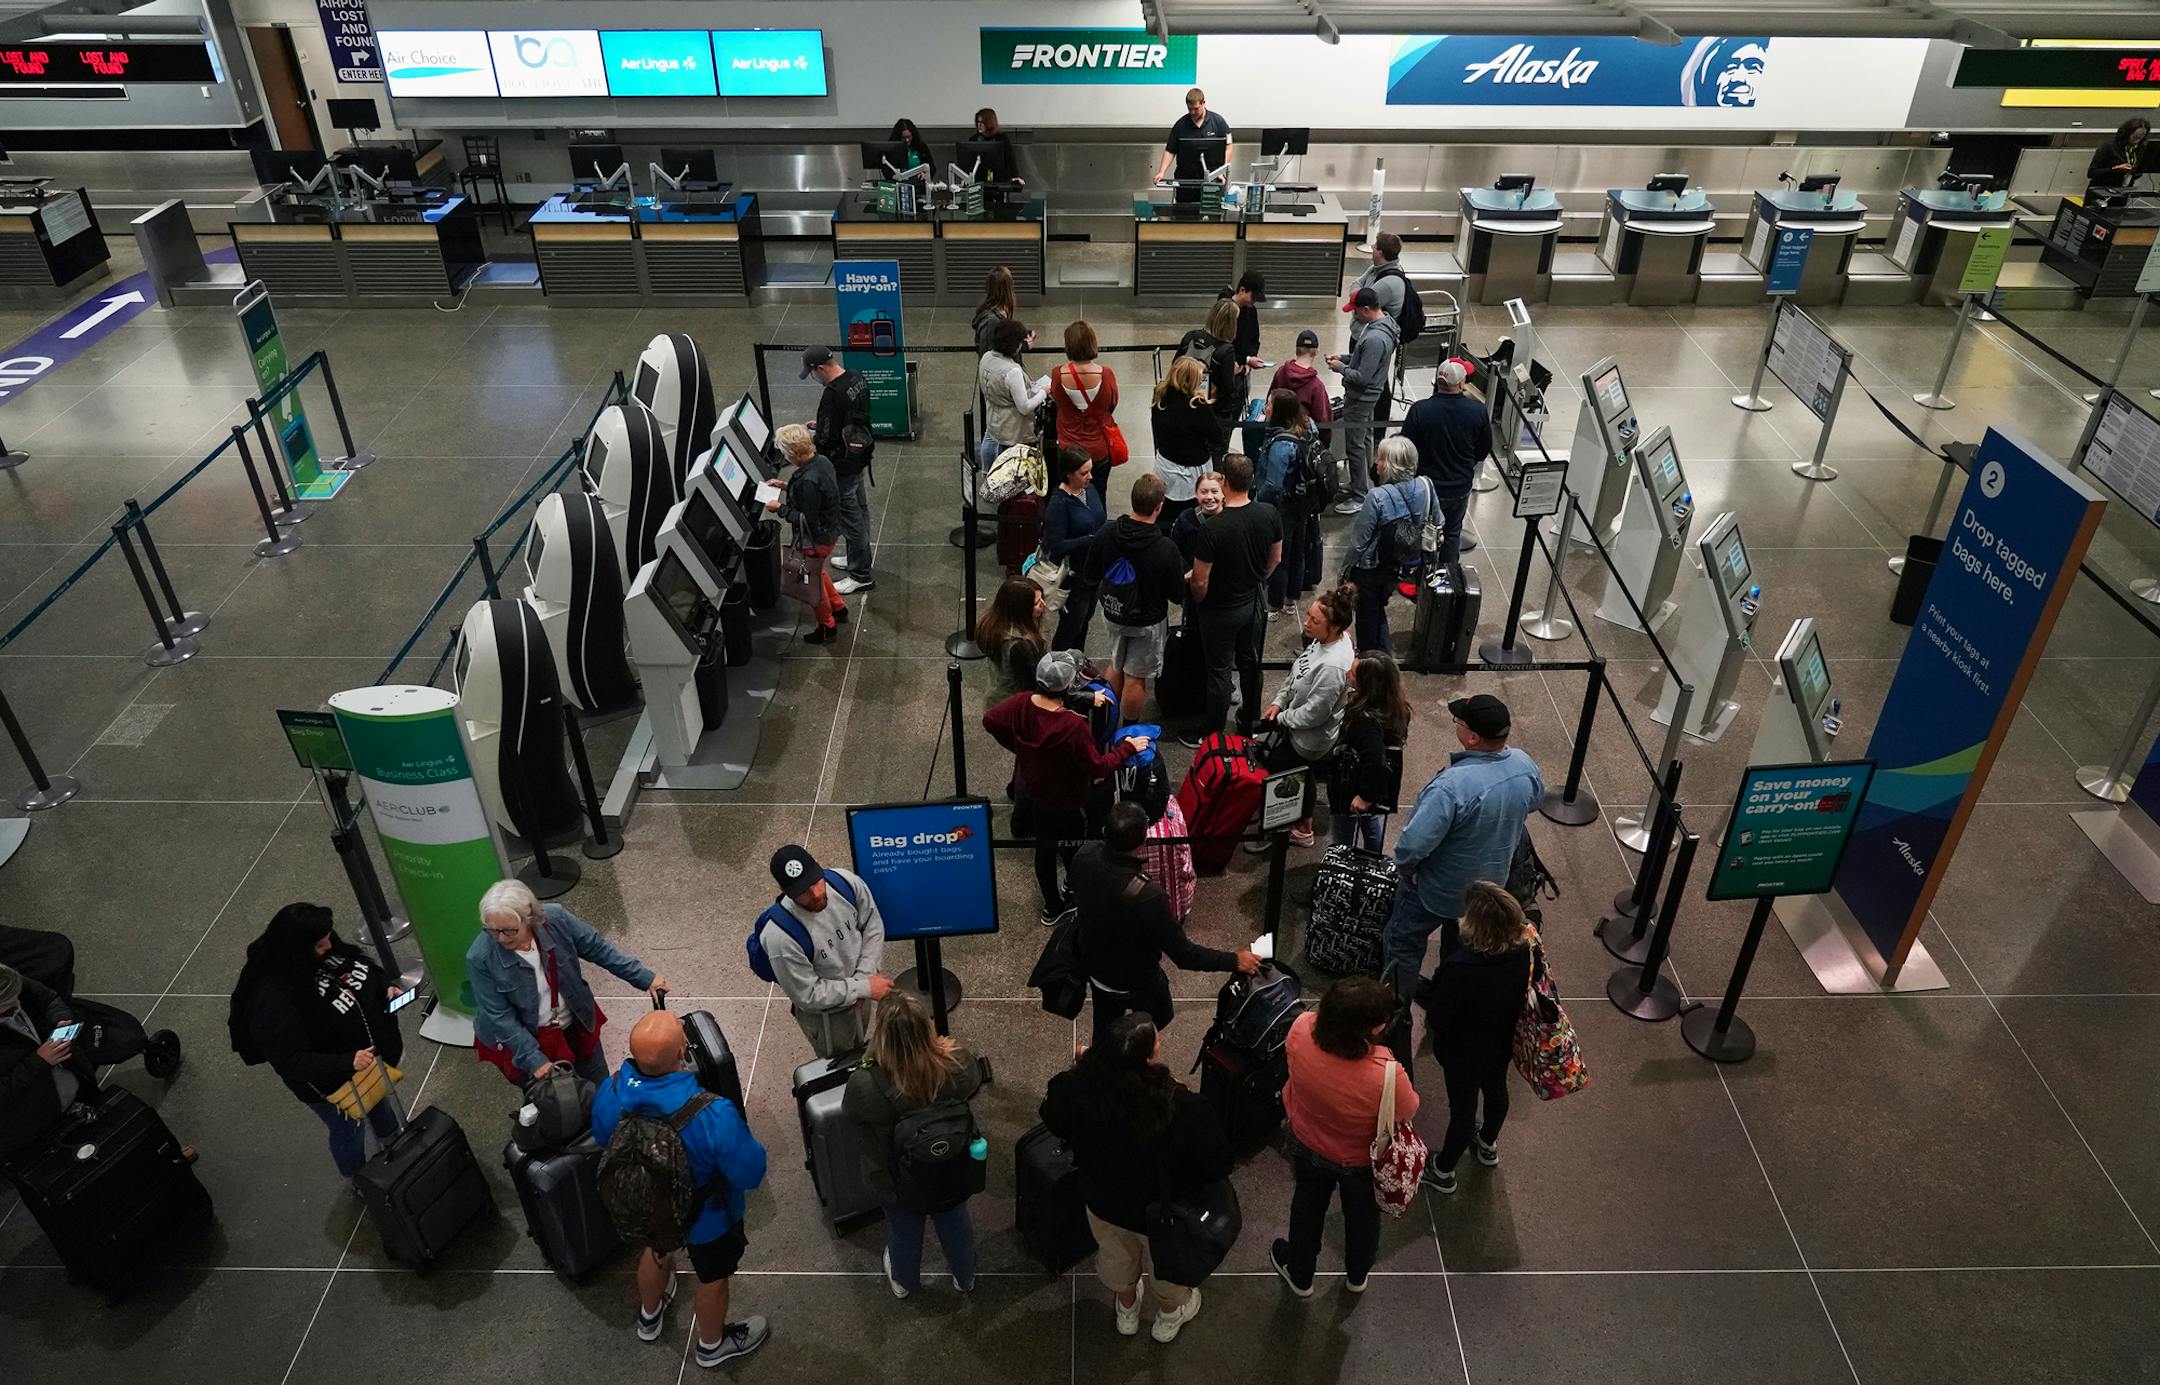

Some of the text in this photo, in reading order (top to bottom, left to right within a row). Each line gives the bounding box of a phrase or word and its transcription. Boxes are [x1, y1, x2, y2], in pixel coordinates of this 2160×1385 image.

[331, 11, 364, 21] LOST
[342, 24, 367, 34] AND
[0, 52, 49, 64] LOST AND
[80, 52, 129, 64] LOST AND
[387, 50, 456, 65] Air Choice
[1011, 43, 1168, 69] FRONTIER
[13, 62, 45, 74] FOUND
[92, 62, 124, 74] FOUND
[621, 58, 679, 72] Aer Lingus
[732, 58, 790, 72] Aer Lingus
[1463, 44, 1600, 88] Alaska
[342, 70, 368, 79] ENTER
[846, 274, 888, 283] Have a
[838, 282, 898, 293] carry-on?
[1987, 470, 1998, 489] 2
[1962, 508, 2047, 590] Drop tagged
[1952, 536, 2014, 605] bags here.
[1928, 604, 1990, 670] Print your tags at
[1921, 624, 1990, 696] a nearby kiosk first.
[376, 766, 458, 779] Business Class
[1752, 776, 1852, 792] Save money
[1749, 790, 1812, 803] on your
[1746, 799, 1820, 814] carry-on!
[870, 832, 960, 848] Bag drop
[908, 847, 938, 856] bought
[1892, 836, 1925, 876] Alaska
[874, 866, 897, 874] pass?
[332, 990, 356, 1014] RE
[347, 960, 369, 990] SOX
